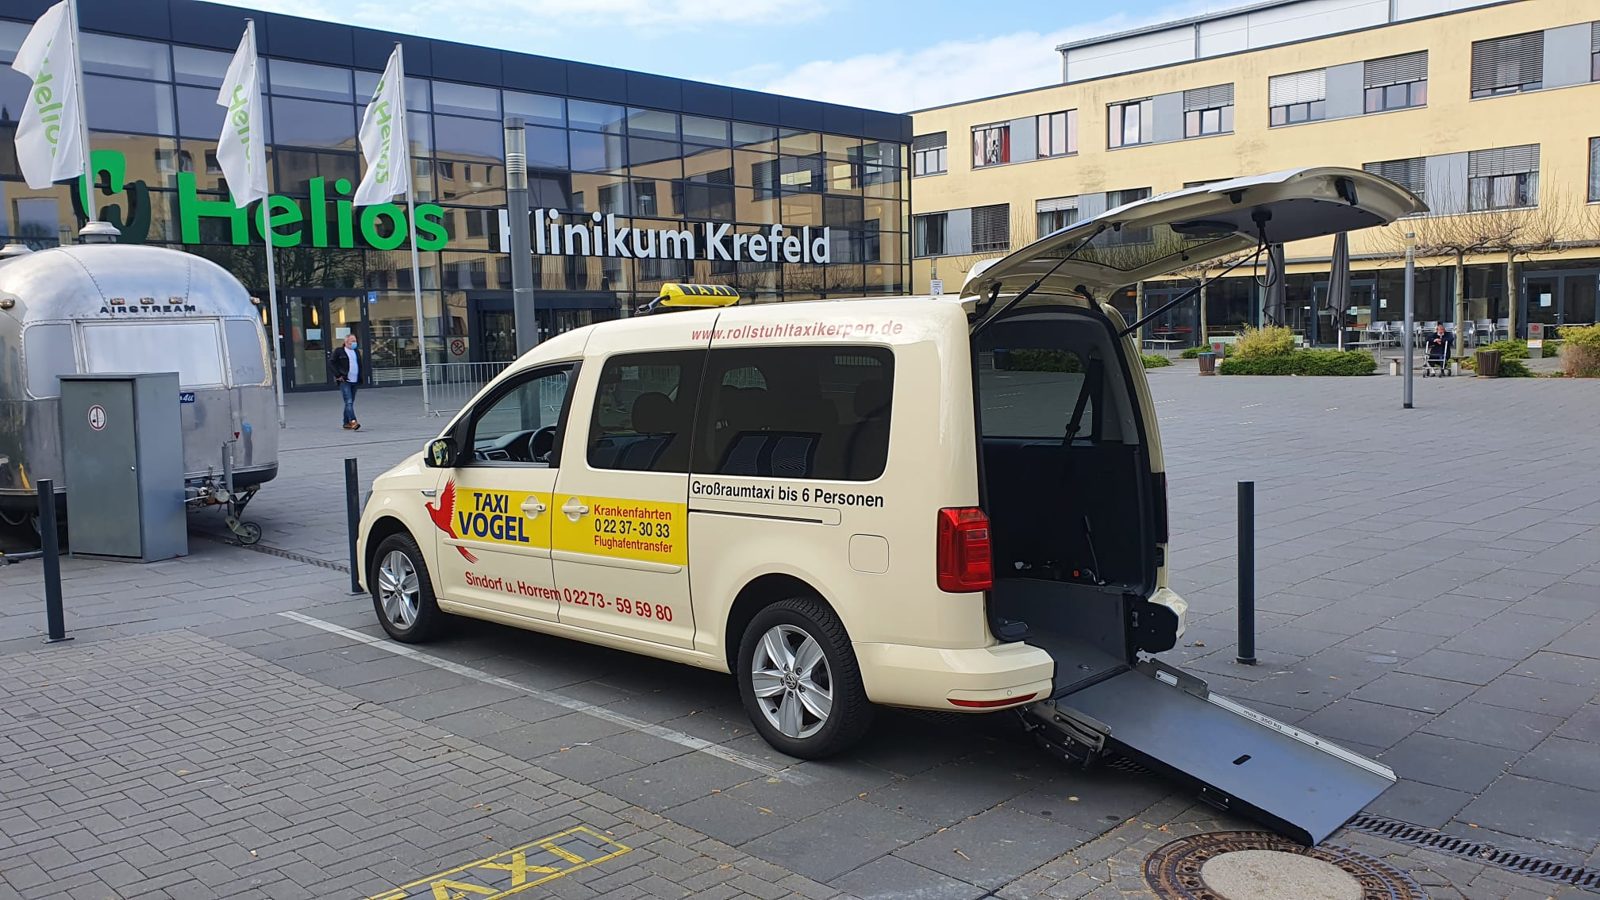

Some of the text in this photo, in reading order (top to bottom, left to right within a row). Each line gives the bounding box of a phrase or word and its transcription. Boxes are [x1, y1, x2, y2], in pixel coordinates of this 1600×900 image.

[177, 171, 449, 251] Helios
[706, 222, 831, 264] Krefeld
[685, 284, 731, 296] TAXI
[100, 304, 196, 313] AIRSTREAM
[691, 320, 904, 341] www.rollstuhltaxikerpen.de
[474, 492, 509, 514] TAXI
[692, 480, 884, 508] Großraumtaxi bis 6 Personen
[594, 504, 672, 521] Krankenfahrten
[458, 511, 530, 543] VOGEL
[655, 523, 670, 538] 33
[594, 535, 673, 553] Flughafentransfer
[465, 573, 503, 592] Sindorf
[505, 581, 517, 594] u.
[517, 580, 562, 601] Horrem
[616, 597, 632, 614] 59
[635, 601, 652, 618] 59
[655, 604, 673, 622] 80
[383, 842, 587, 900] AXI
